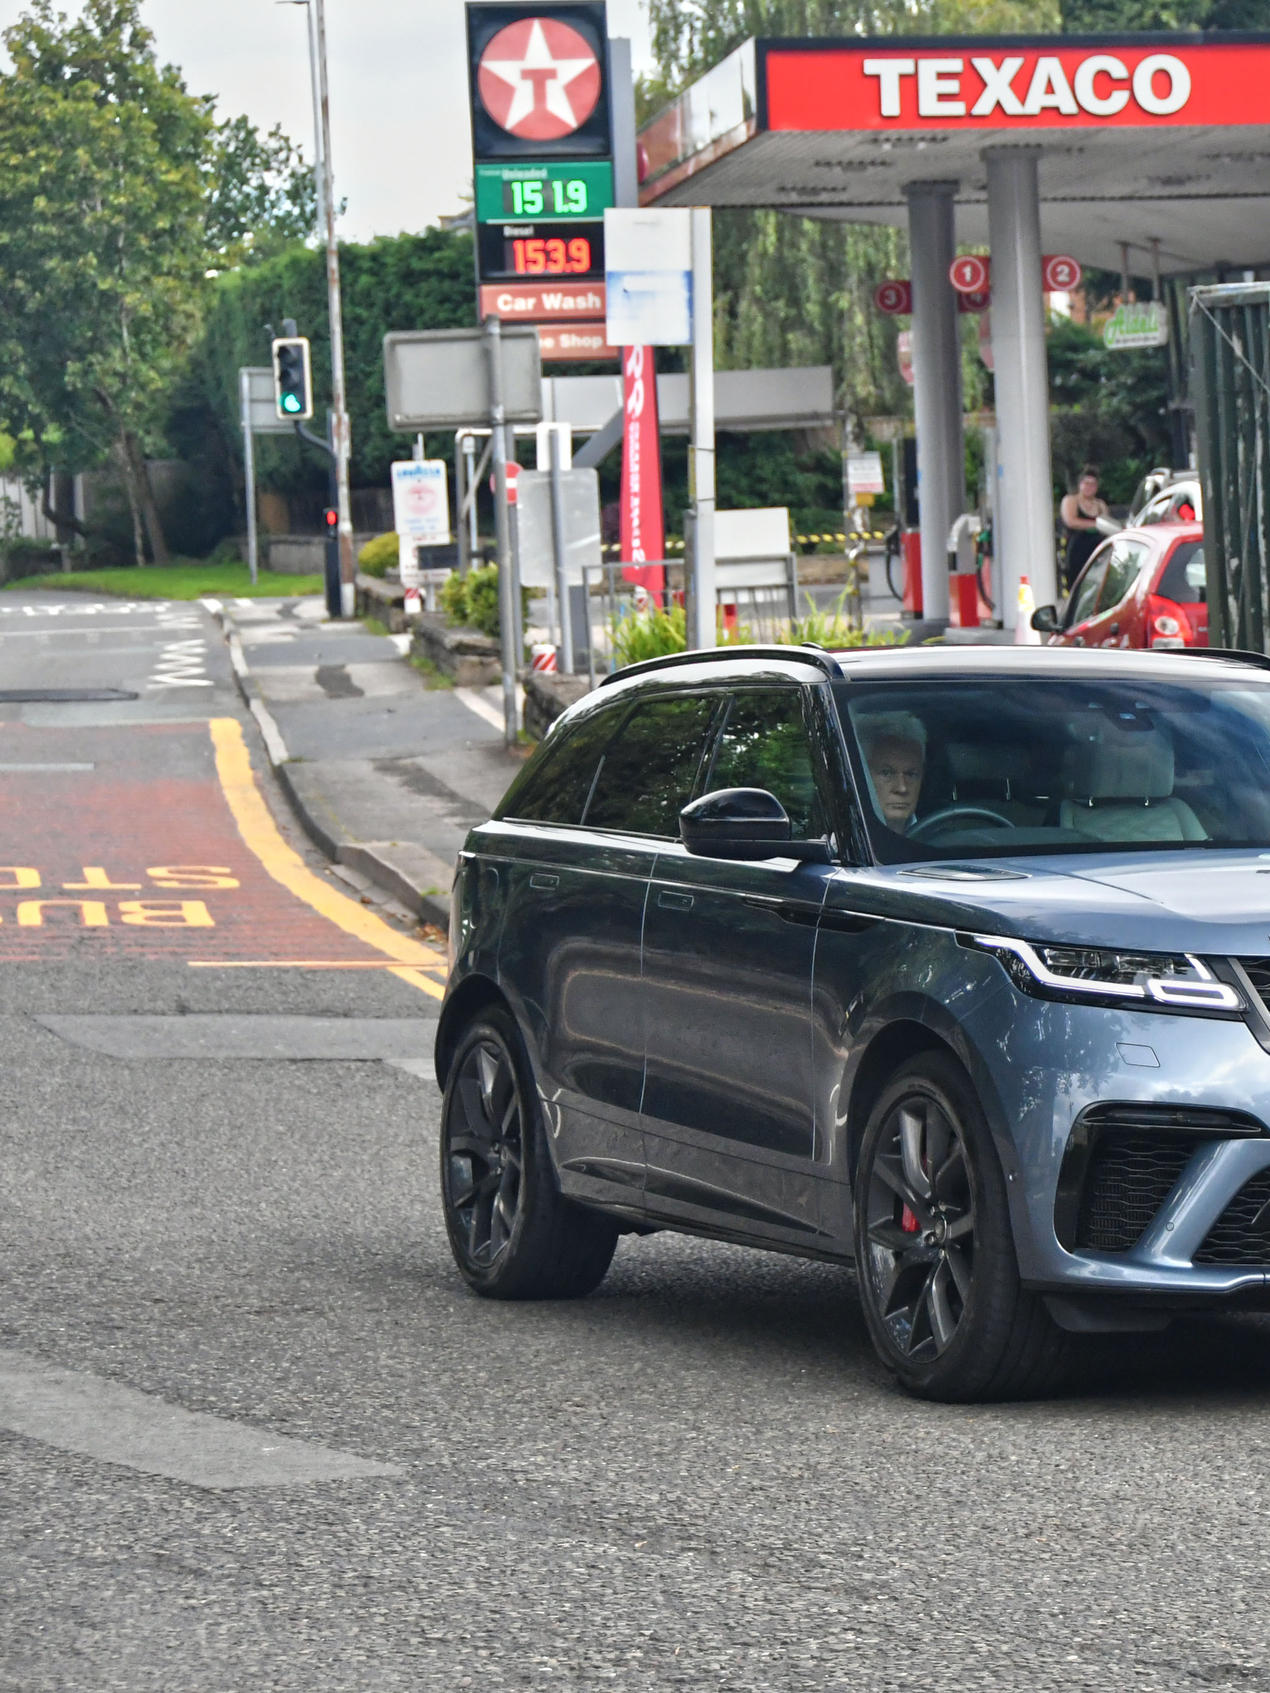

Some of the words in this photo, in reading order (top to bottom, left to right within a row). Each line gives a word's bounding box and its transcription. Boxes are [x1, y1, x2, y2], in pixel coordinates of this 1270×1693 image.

[863, 53, 1192, 117] TEXACO
[503, 225, 534, 237] Diesel
[513, 237, 592, 274] 153.9
[962, 265, 973, 282] 1
[1056, 265, 1070, 282] 2
[497, 294, 537, 311] Car
[541, 292, 601, 310] Wash
[884, 290, 897, 305] 3
[559, 334, 603, 349] Shop
[0, 900, 215, 927] BU
